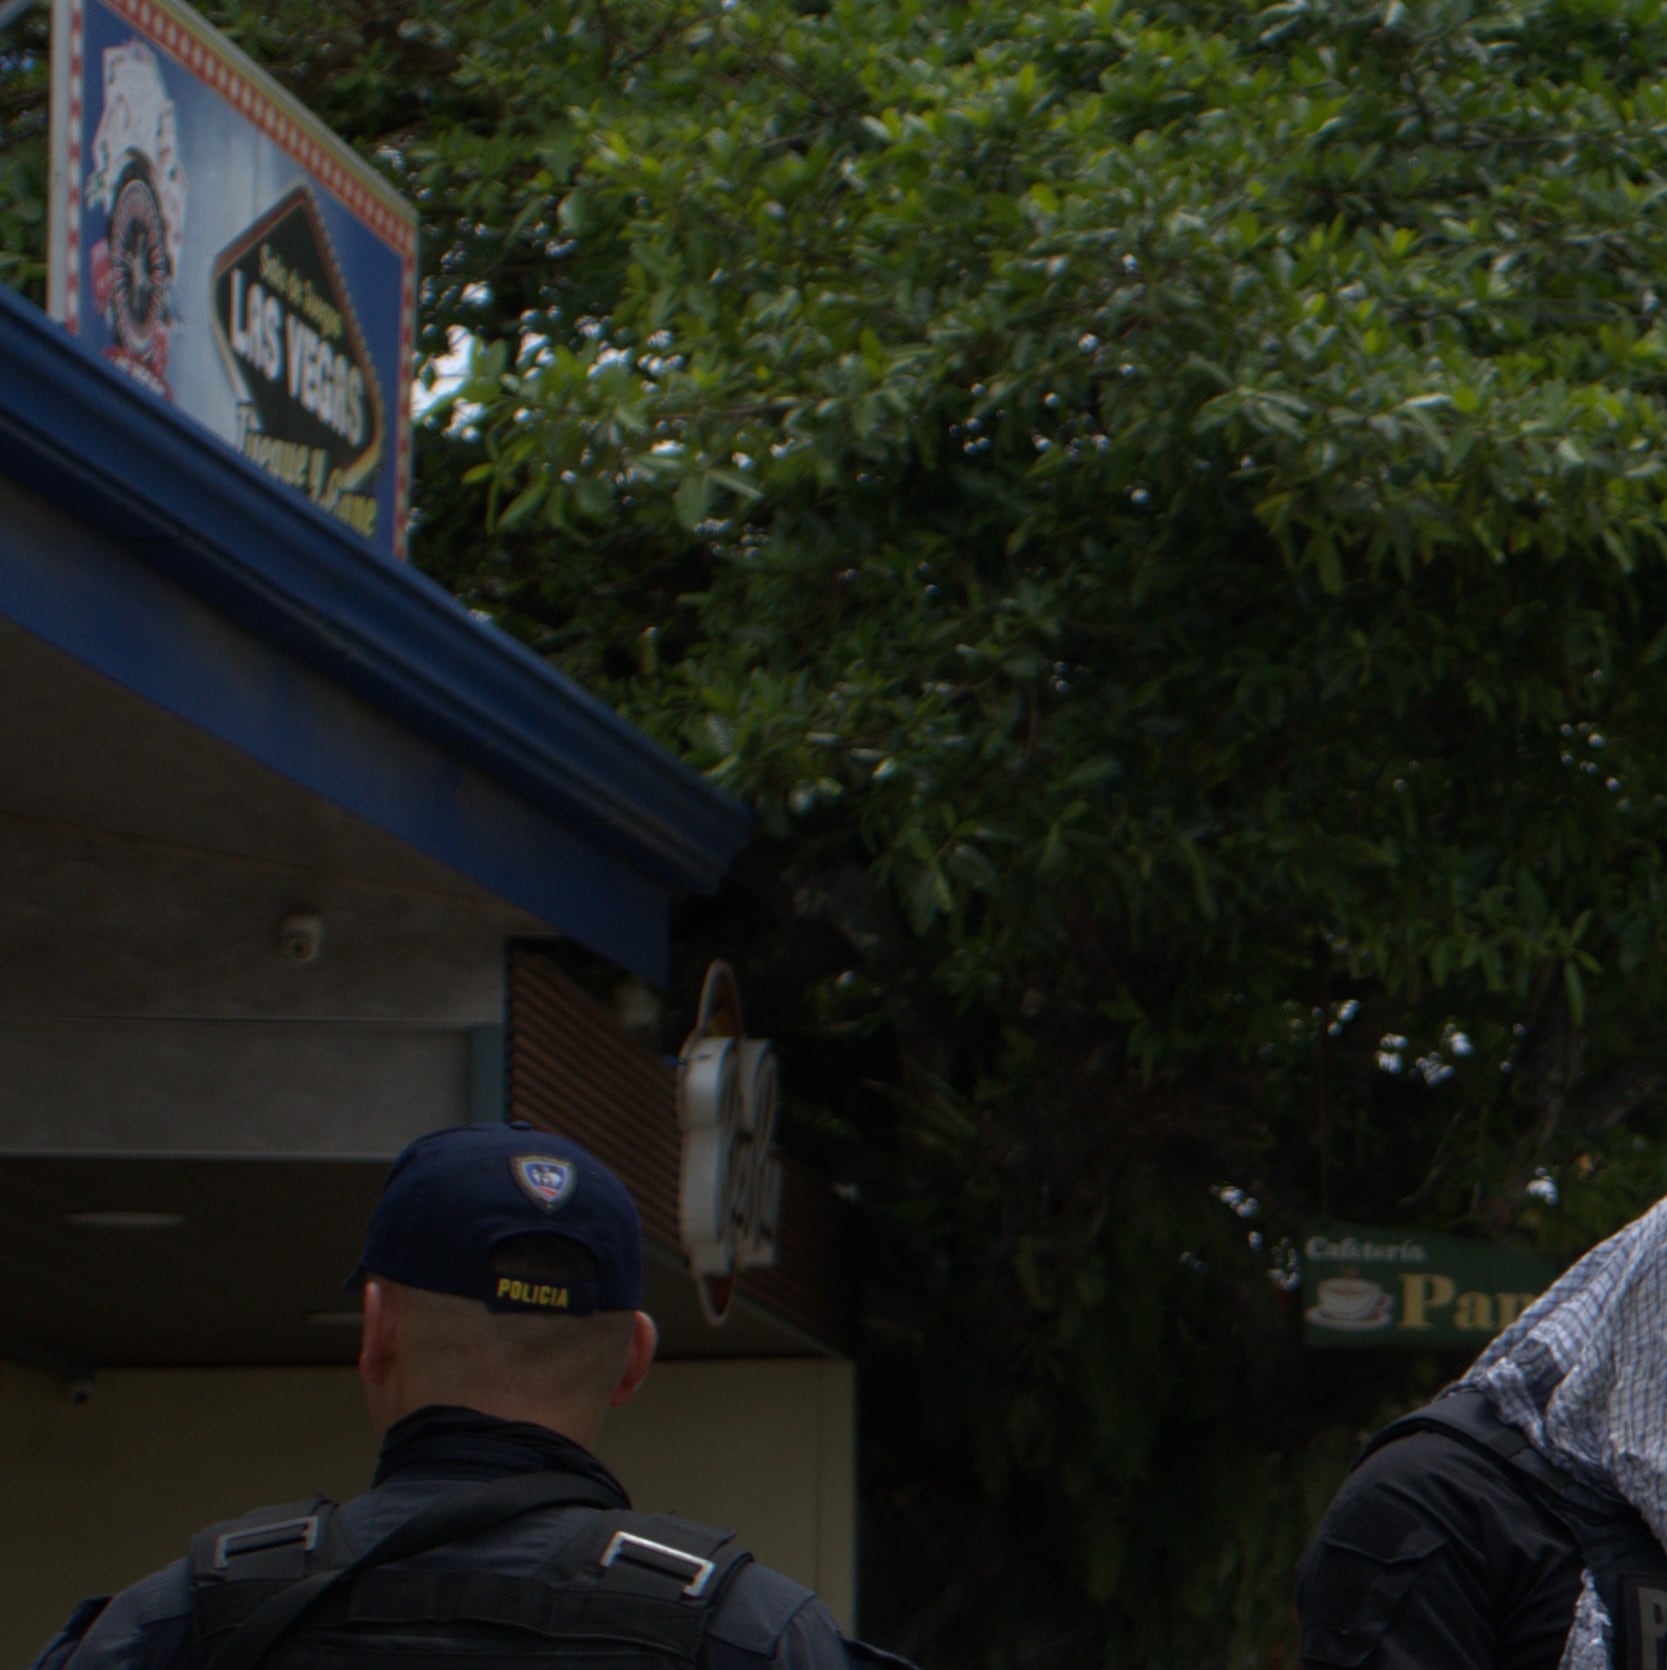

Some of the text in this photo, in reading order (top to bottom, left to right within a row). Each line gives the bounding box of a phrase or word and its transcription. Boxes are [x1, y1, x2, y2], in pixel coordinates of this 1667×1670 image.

[230, 267, 364, 449] LAS VEGAS
[496, 1277, 568, 1308] POLICIA
